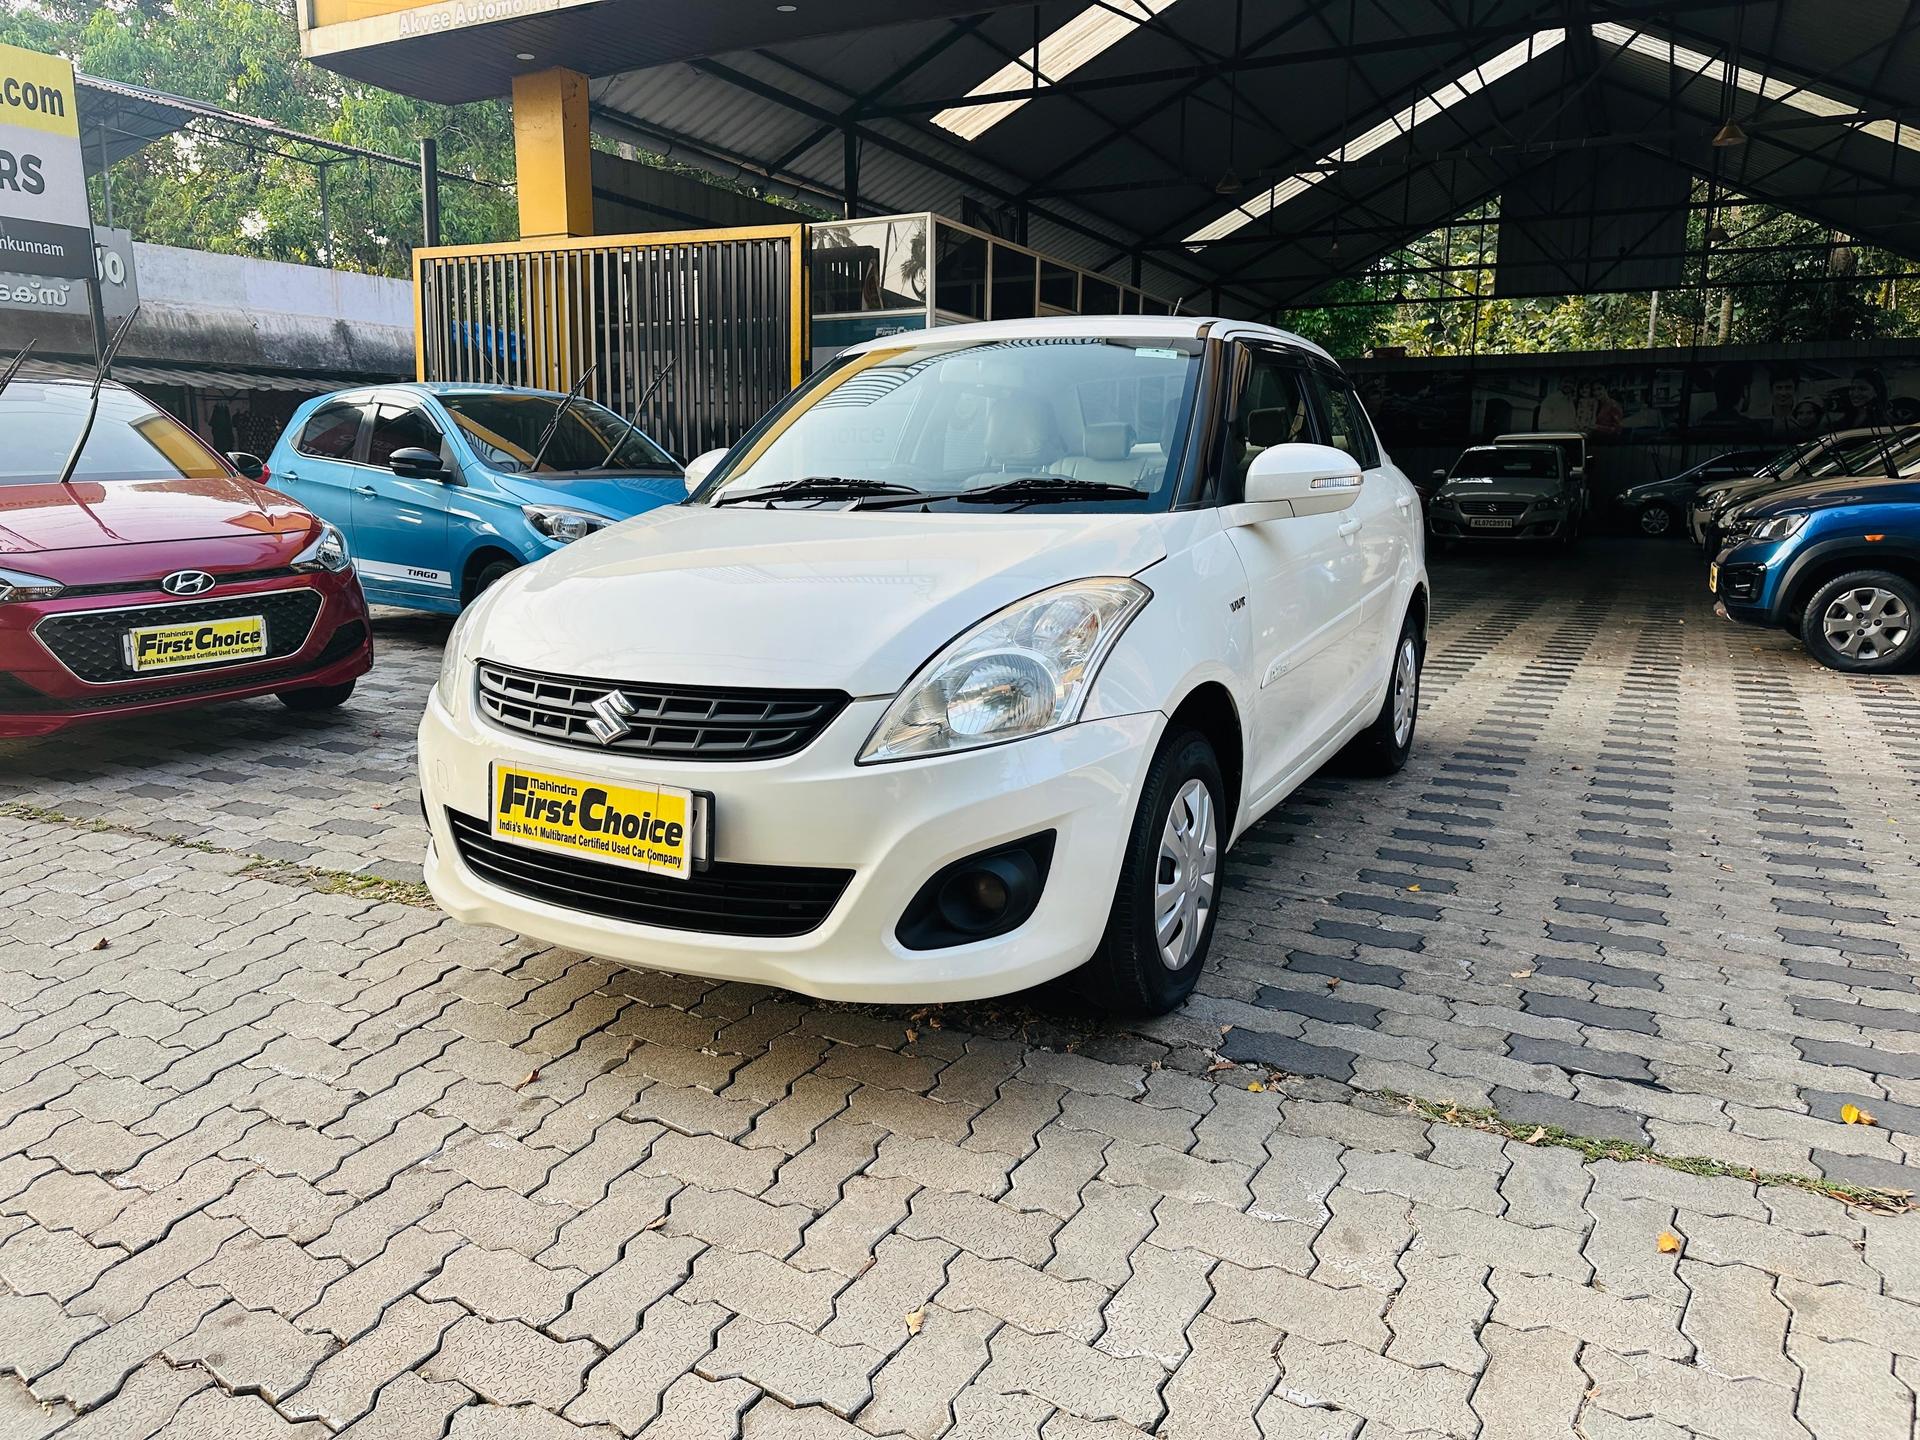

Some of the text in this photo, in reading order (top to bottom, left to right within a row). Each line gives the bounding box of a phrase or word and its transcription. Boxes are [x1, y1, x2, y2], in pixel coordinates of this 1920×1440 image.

[400, 12, 451, 36] Akvee
[407, 568, 439, 580] TIAGO
[138, 633, 194, 657] First
[195, 627, 261, 650] Choice
[159, 630, 194, 639] Mahindra
[139, 657, 156, 666] India's
[156, 656, 169, 664] No.1
[169, 653, 196, 663] Multibrand
[197, 650, 218, 659] Certified
[231, 647, 240, 655] Car
[240, 645, 262, 655] Company
[530, 778, 577, 796] Mahindra
[500, 773, 683, 846] First Choice
[500, 819, 682, 869] India's No.1 Multibrand Certified Used Car Company
